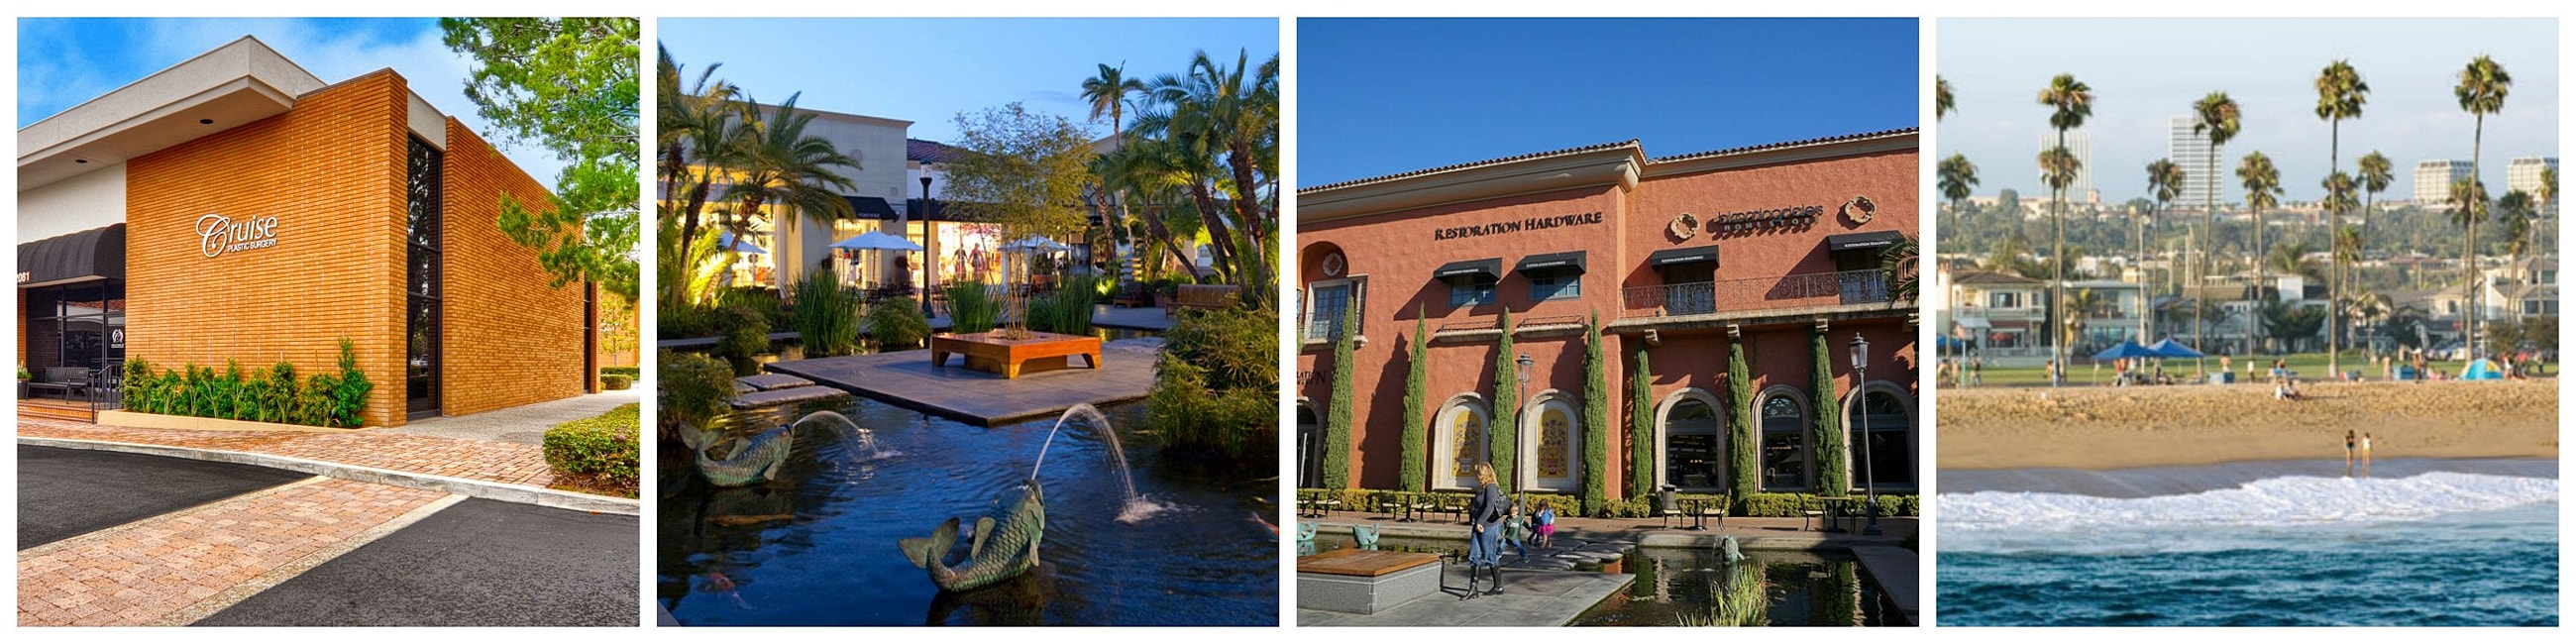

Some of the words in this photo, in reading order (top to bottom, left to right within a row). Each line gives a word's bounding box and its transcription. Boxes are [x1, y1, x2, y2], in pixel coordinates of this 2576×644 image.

[196, 214, 277, 258] Cruise
[1435, 220, 1521, 241] RESTORATION
[1525, 211, 1602, 231] HARDWARE
[1724, 222, 1761, 231] HOME
[228, 244, 249, 253] PLASTIC
[250, 239, 277, 250] SURGERY
